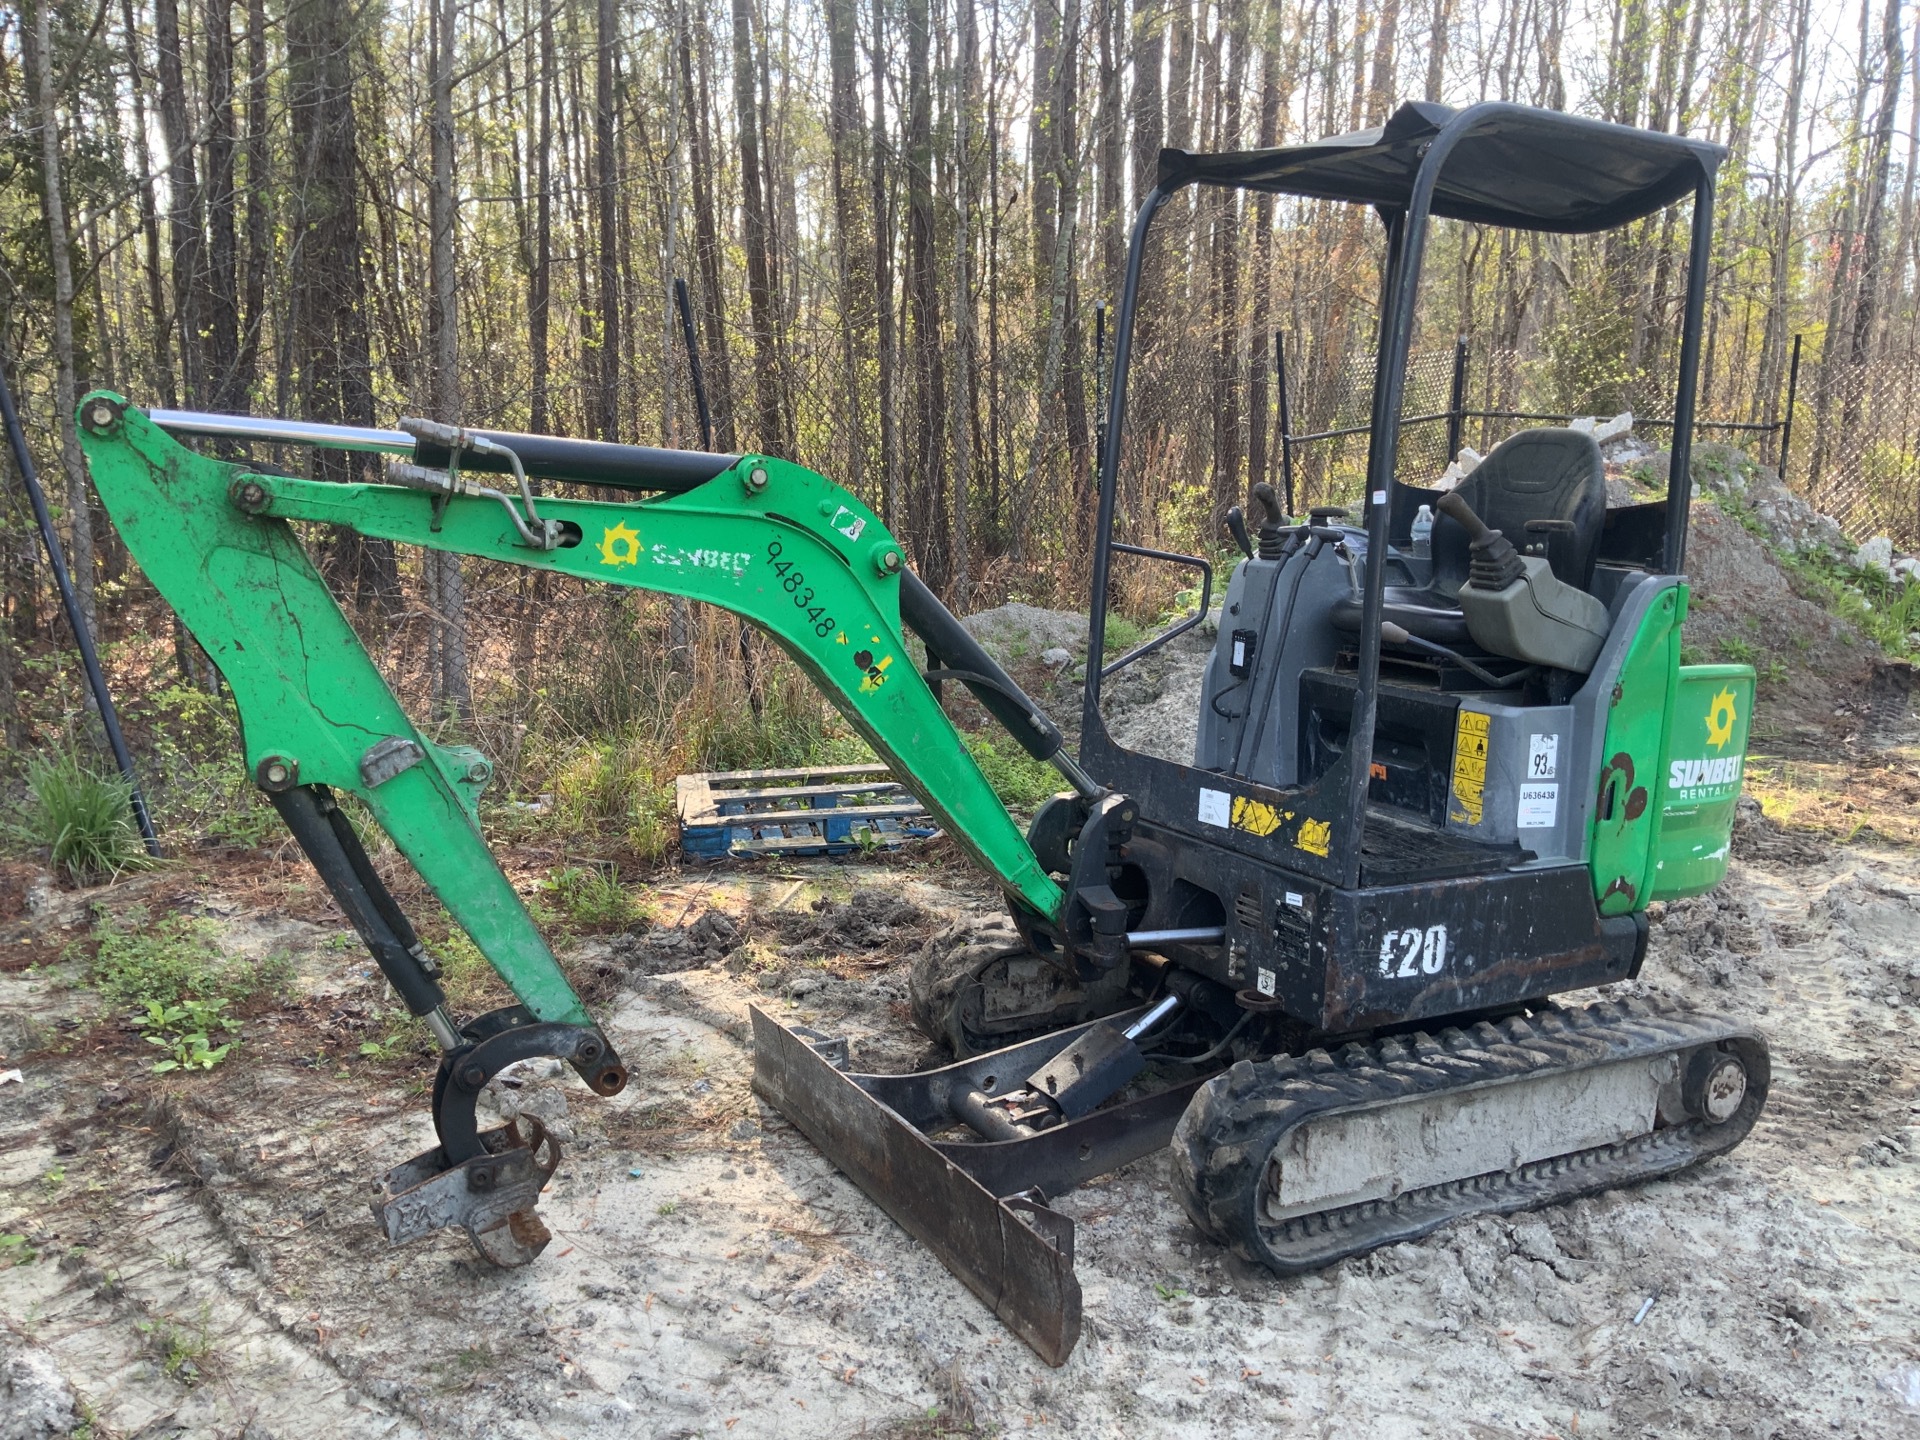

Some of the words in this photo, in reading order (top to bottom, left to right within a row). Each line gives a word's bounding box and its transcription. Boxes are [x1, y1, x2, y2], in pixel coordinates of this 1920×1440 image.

[766, 541, 835, 637] 948348
[1534, 753, 1548, 776] 93
[1669, 755, 1741, 788] SUNBELT
[1523, 791, 1555, 800] U636438
